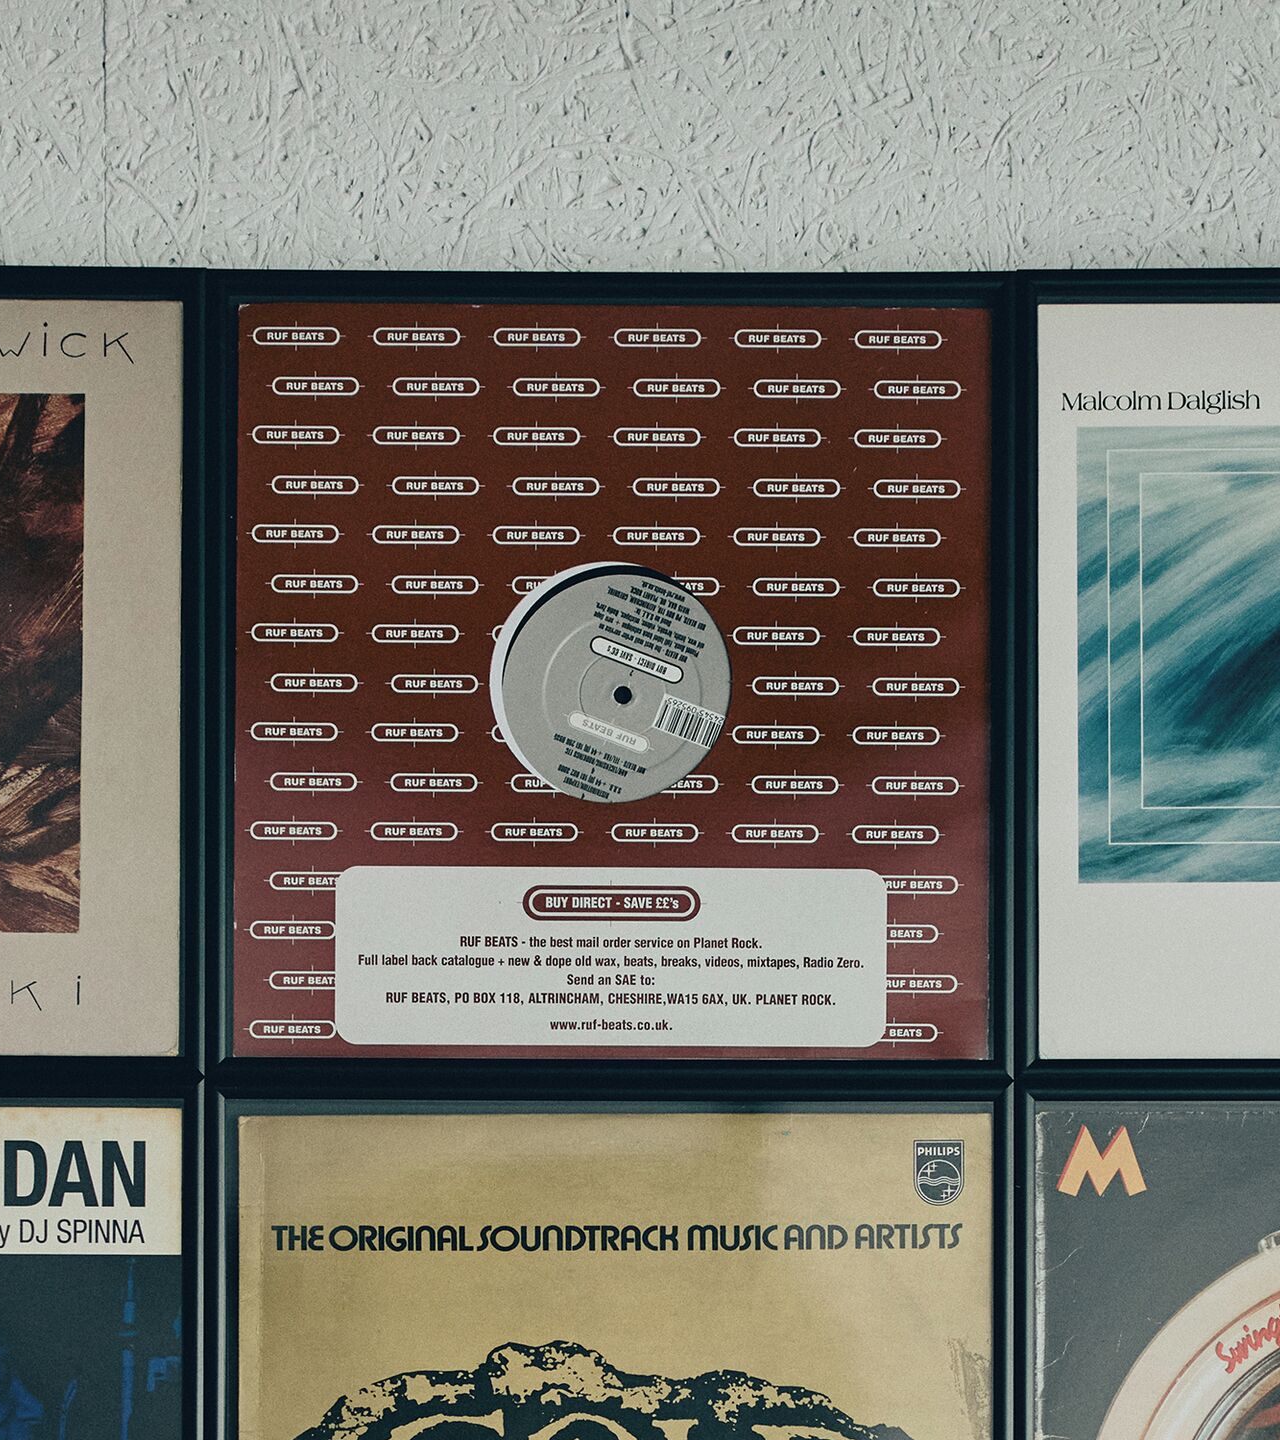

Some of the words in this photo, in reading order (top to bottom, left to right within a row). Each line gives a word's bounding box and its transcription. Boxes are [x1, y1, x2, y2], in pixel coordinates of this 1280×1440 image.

[266, 331, 289, 341] RUF
[291, 331, 325, 341] BEATS
[386, 332, 409, 342] RUF
[411, 332, 445, 342] BEATS
[507, 332, 530, 342] RUF
[532, 332, 566, 342] BEATS
[627, 333, 650, 343] RUF
[652, 333, 686, 343] BEATS
[748, 334, 771, 344] RUF
[773, 334, 807, 344] BEATS
[868, 335, 891, 345] RUF
[893, 335, 927, 345] BEATS
[1061, 390, 1162, 411] Malcolm
[1167, 389, 1261, 415] Dalglish
[285, 480, 308, 490] RUF
[310, 480, 344, 490] BEATS
[405, 481, 428, 491] RUF
[430, 481, 464, 491] BEATS
[526, 481, 549, 491] RUF
[551, 481, 585, 491] BEATS
[646, 482, 669, 492] RUF
[671, 482, 705, 492] BEATS
[767, 483, 790, 493] RUF
[792, 483, 826, 493] BEATS
[887, 483, 910, 493] RUF
[912, 483, 946, 493] BEATS
[582, 719, 614, 736] BEATS
[616, 733, 636, 745] RUF
[264, 826, 287, 836] RUF
[289, 826, 323, 836] BEATS
[384, 827, 407, 837] RUF
[409, 827, 443, 837] BEATS
[505, 827, 528, 837] RUF
[530, 827, 564, 837] BEATS
[625, 828, 648, 838] RUF
[650, 828, 684, 838] BEATS
[746, 829, 769, 839] RUF
[771, 829, 805, 839] BEATS
[866, 829, 889, 839] RUF
[891, 829, 925, 839] BEATS
[545, 896, 569, 909] BUY
[571, 896, 613, 909] DIRECT
[623, 896, 653, 909] SAVE
[460, 935, 482, 948] RUF
[484, 935, 519, 948] BEATS
[528, 936, 547, 948] the
[549, 936, 574, 948] best
[576, 936, 600, 948] mail
[602, 936, 632, 949] order
[634, 936, 674, 949] service
[676, 939, 690, 949] on
[693, 937, 729, 949] Planet
[731, 937, 763, 949] Rock.
[358, 954, 378, 966] Full
[381, 954, 408, 966] label
[411, 954, 438, 966] back
[441, 954, 495, 969] catalogue
[507, 957, 531, 967] new
[533, 954, 542, 967] &
[545, 954, 572, 969] dope
[574, 955, 592, 967] old
[594, 957, 620, 969] wax,
[623, 955, 658, 969] beats,
[661, 955, 701, 969] breaks,
[704, 955, 744, 969] videos,
[747, 955, 800, 971] mixtapes,
[803, 956, 834, 969] Radio
[836, 956, 864, 969] Zero.
[566, 973, 594, 986] Send
[597, 976, 612, 986] an
[614, 973, 637, 986] SAE
[640, 974, 655, 986] to:
[385, 991, 408, 1004] RUF
[411, 991, 451, 1005] BEATS,
[454, 991, 470, 1004] PO
[473, 992, 496, 1004] BOX
[499, 992, 524, 1006] 118,
[528, 992, 604, 1006] ALTRINCHAM,
[701, 993, 728, 1007] 6AX,
[732, 993, 752, 1005] UK.
[755, 993, 798, 1006] PLANET
[801, 993, 836, 1006] ROCK.
[549, 1018, 673, 1031] www.ruf-beats.co.uk.
[917, 1146, 961, 1156] PHILIPS
[19, 1218, 48, 1244] DJ
[56, 1218, 145, 1244] SPINNA
[270, 1225, 324, 1251] THE
[328, 1224, 473, 1252] ORIGINAL
[476, 1224, 679, 1252] SOUNDTRACK
[687, 1224, 779, 1252] MUSIC
[783, 1224, 849, 1251] AND
[855, 1223, 963, 1250] ARTISTS
